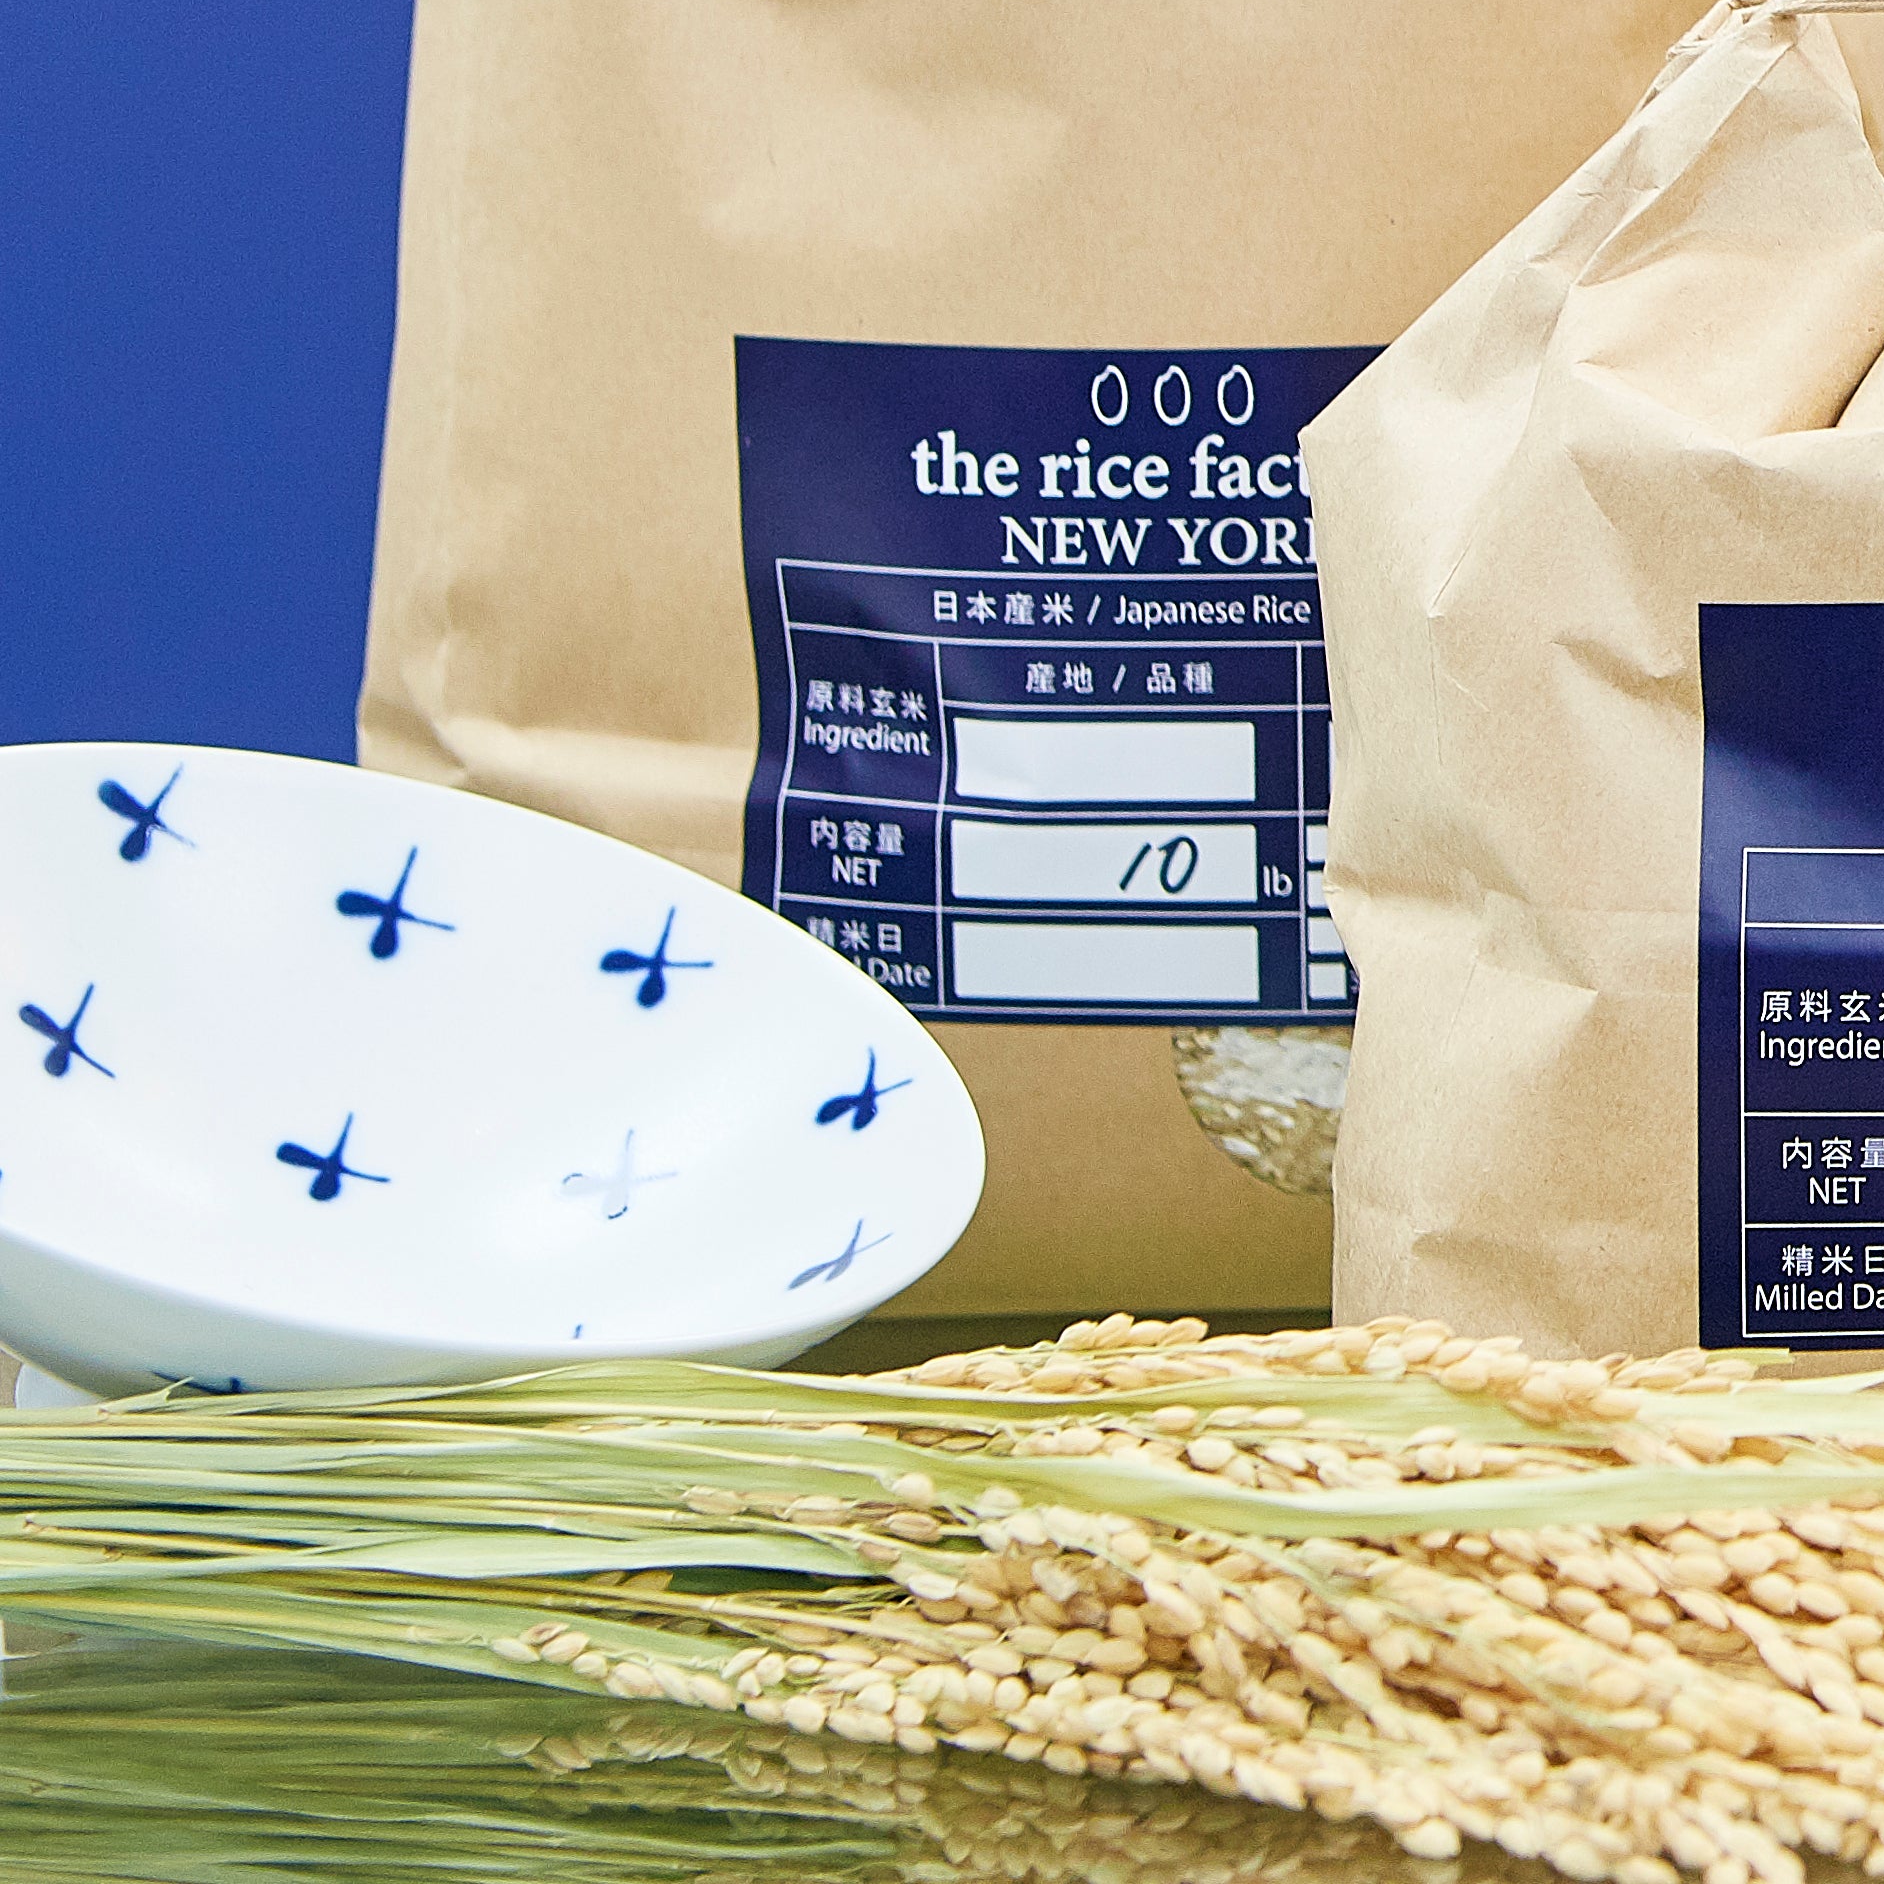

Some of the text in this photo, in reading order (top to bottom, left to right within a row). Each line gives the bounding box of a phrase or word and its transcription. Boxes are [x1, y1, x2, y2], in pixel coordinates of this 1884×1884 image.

[911, 429, 1019, 497] the
[1037, 438, 1169, 499] rice
[1000, 516, 1151, 566] NEW
[933, 590, 1074, 627] 日本産米
[1113, 595, 1245, 628] Japanese
[1253, 595, 1310, 624] Rice
[1025, 662, 1094, 695] 産地
[1146, 662, 1215, 695] 品種
[805, 679, 927, 720] 原料玄米
[803, 717, 932, 757] Ingredient
[810, 816, 905, 856] 内容量
[832, 854, 883, 887] NET
[1117, 836, 1199, 895] 10
[1263, 866, 1292, 900] lb
[868, 957, 932, 988] Date
[1809, 1177, 1866, 1206] NET
[1755, 1282, 1844, 1311] Milled
